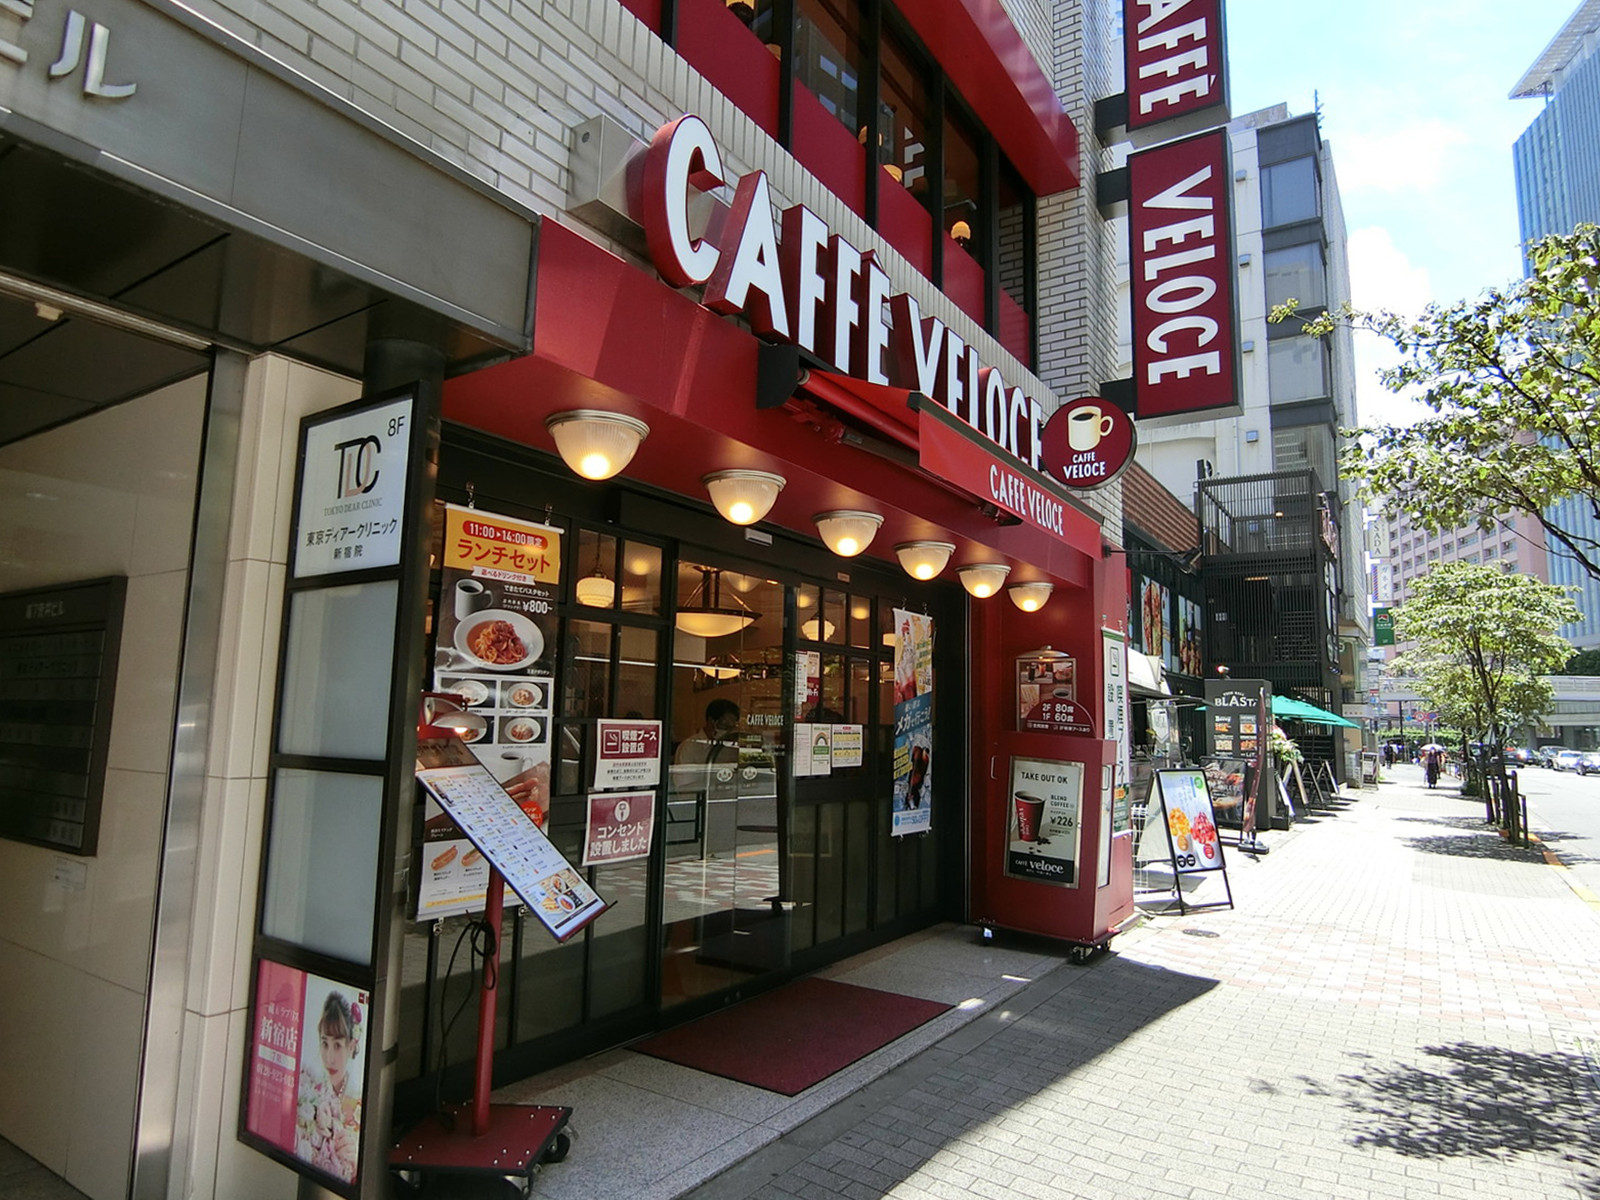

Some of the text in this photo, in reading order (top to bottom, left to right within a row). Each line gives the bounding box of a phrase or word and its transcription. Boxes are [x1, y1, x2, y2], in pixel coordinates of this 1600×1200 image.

[1142, 163, 1220, 386] VELOCE
[902, 292, 1043, 472] VELOCE
[387, 415, 406, 437] 8F
[1062, 461, 1106, 480] VELOCE
[323, 497, 384, 517] TOKYO DEAR CLINIC
[1027, 485, 1064, 537] VELOCE
[305, 517, 398, 548] 東京ディアークリニック
[469, 522, 495, 539] 11:00
[333, 544, 364, 560] 新宿院
[457, 538, 551, 574] ランチセット
[503, 584, 550, 598] できたてパスタセット
[1042, 703, 1075, 713] 2F 80席
[1042, 712, 1075, 723] 1F 60席
[621, 729, 658, 742] 喫煙ブース
[621, 741, 646, 754] 設置店
[1021, 771, 1068, 785] TAKE OUT OK
[1050, 794, 1067, 802] BLEND
[1050, 801, 1070, 809] COFFEE
[596, 821, 644, 839] コンセント
[1049, 816, 1074, 828] ¥226
[589, 836, 648, 858] 設置しました
[1029, 859, 1065, 875] veloce
